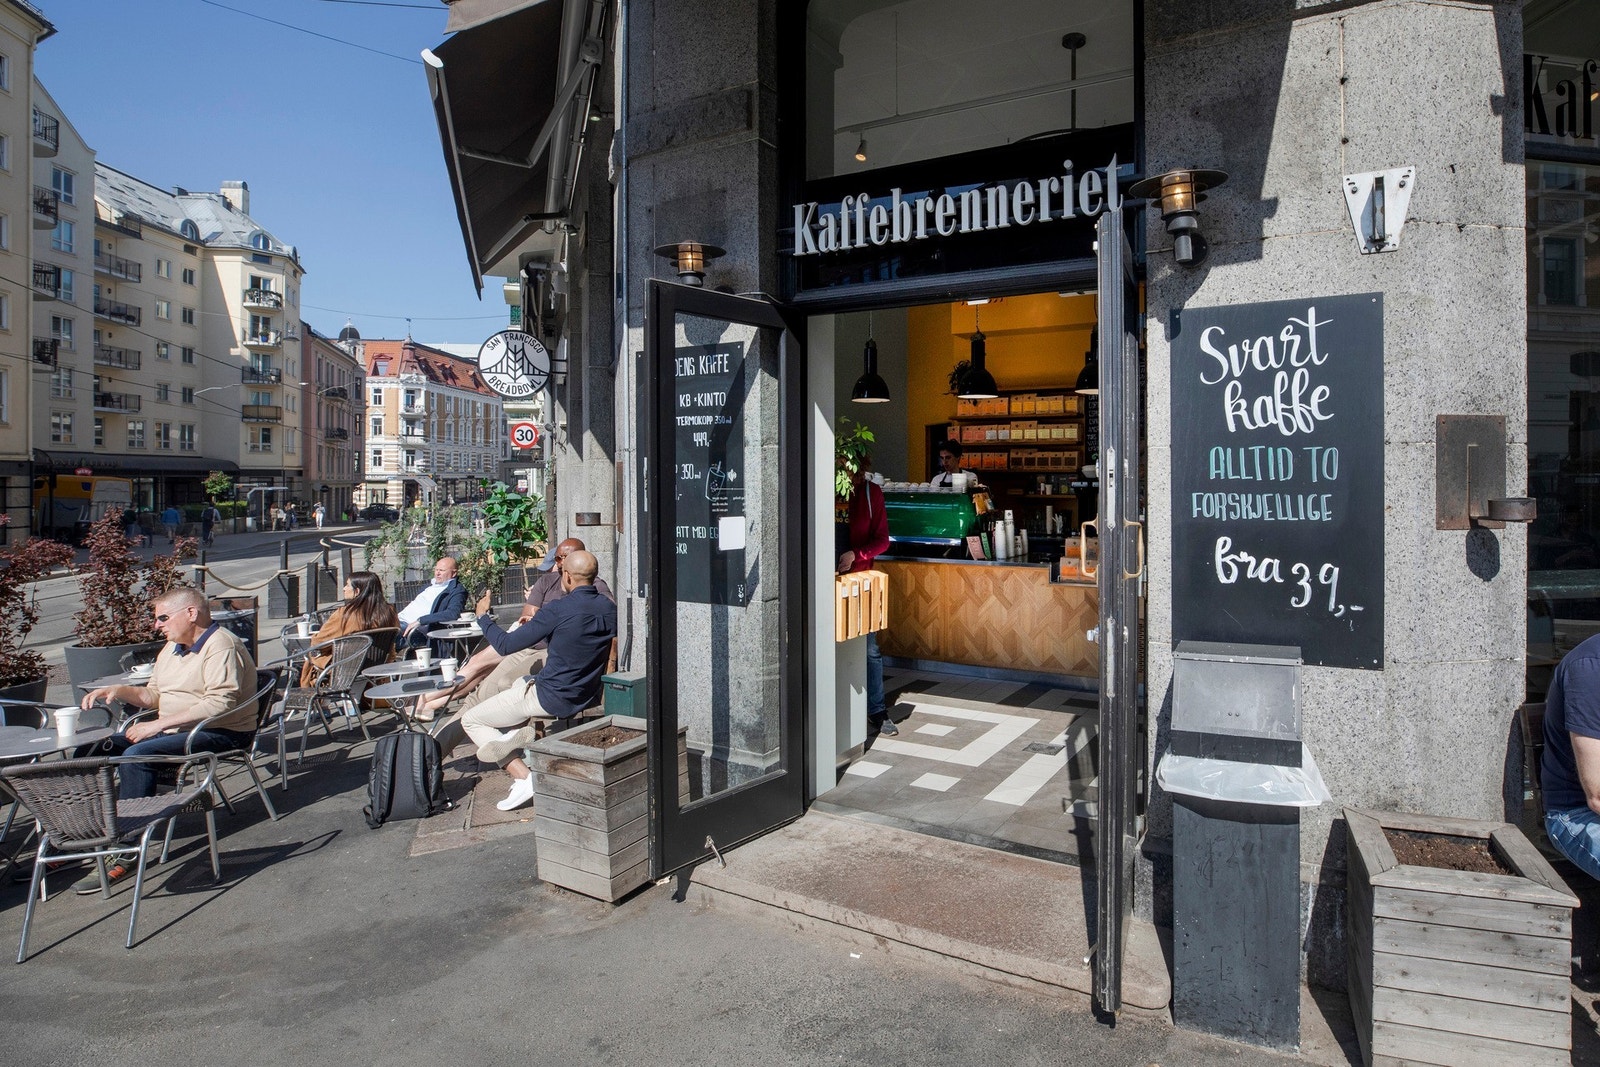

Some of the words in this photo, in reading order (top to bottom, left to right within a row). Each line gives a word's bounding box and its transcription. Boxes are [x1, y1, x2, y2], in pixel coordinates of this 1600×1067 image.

[793, 152, 1124, 256] Kaffebrenneriet
[486, 337, 502, 351] SAN
[504, 332, 544, 354] FRANCISCO
[1200, 306, 1334, 385] Svart
[699, 353, 730, 375] KAFFE
[488, 375, 542, 395] BREADBOWL
[679, 393, 691, 407] KB
[697, 391, 727, 407] KINTO
[1224, 367, 1335, 437] kaffe
[676, 415, 713, 426] TERMOKOPP
[516, 429, 534, 442] 30
[1209, 445, 1294, 481] ALLTID
[1302, 446, 1339, 483] TO
[1191, 492, 1333, 521] FORSKJELLIGE
[692, 526, 707, 539] MED
